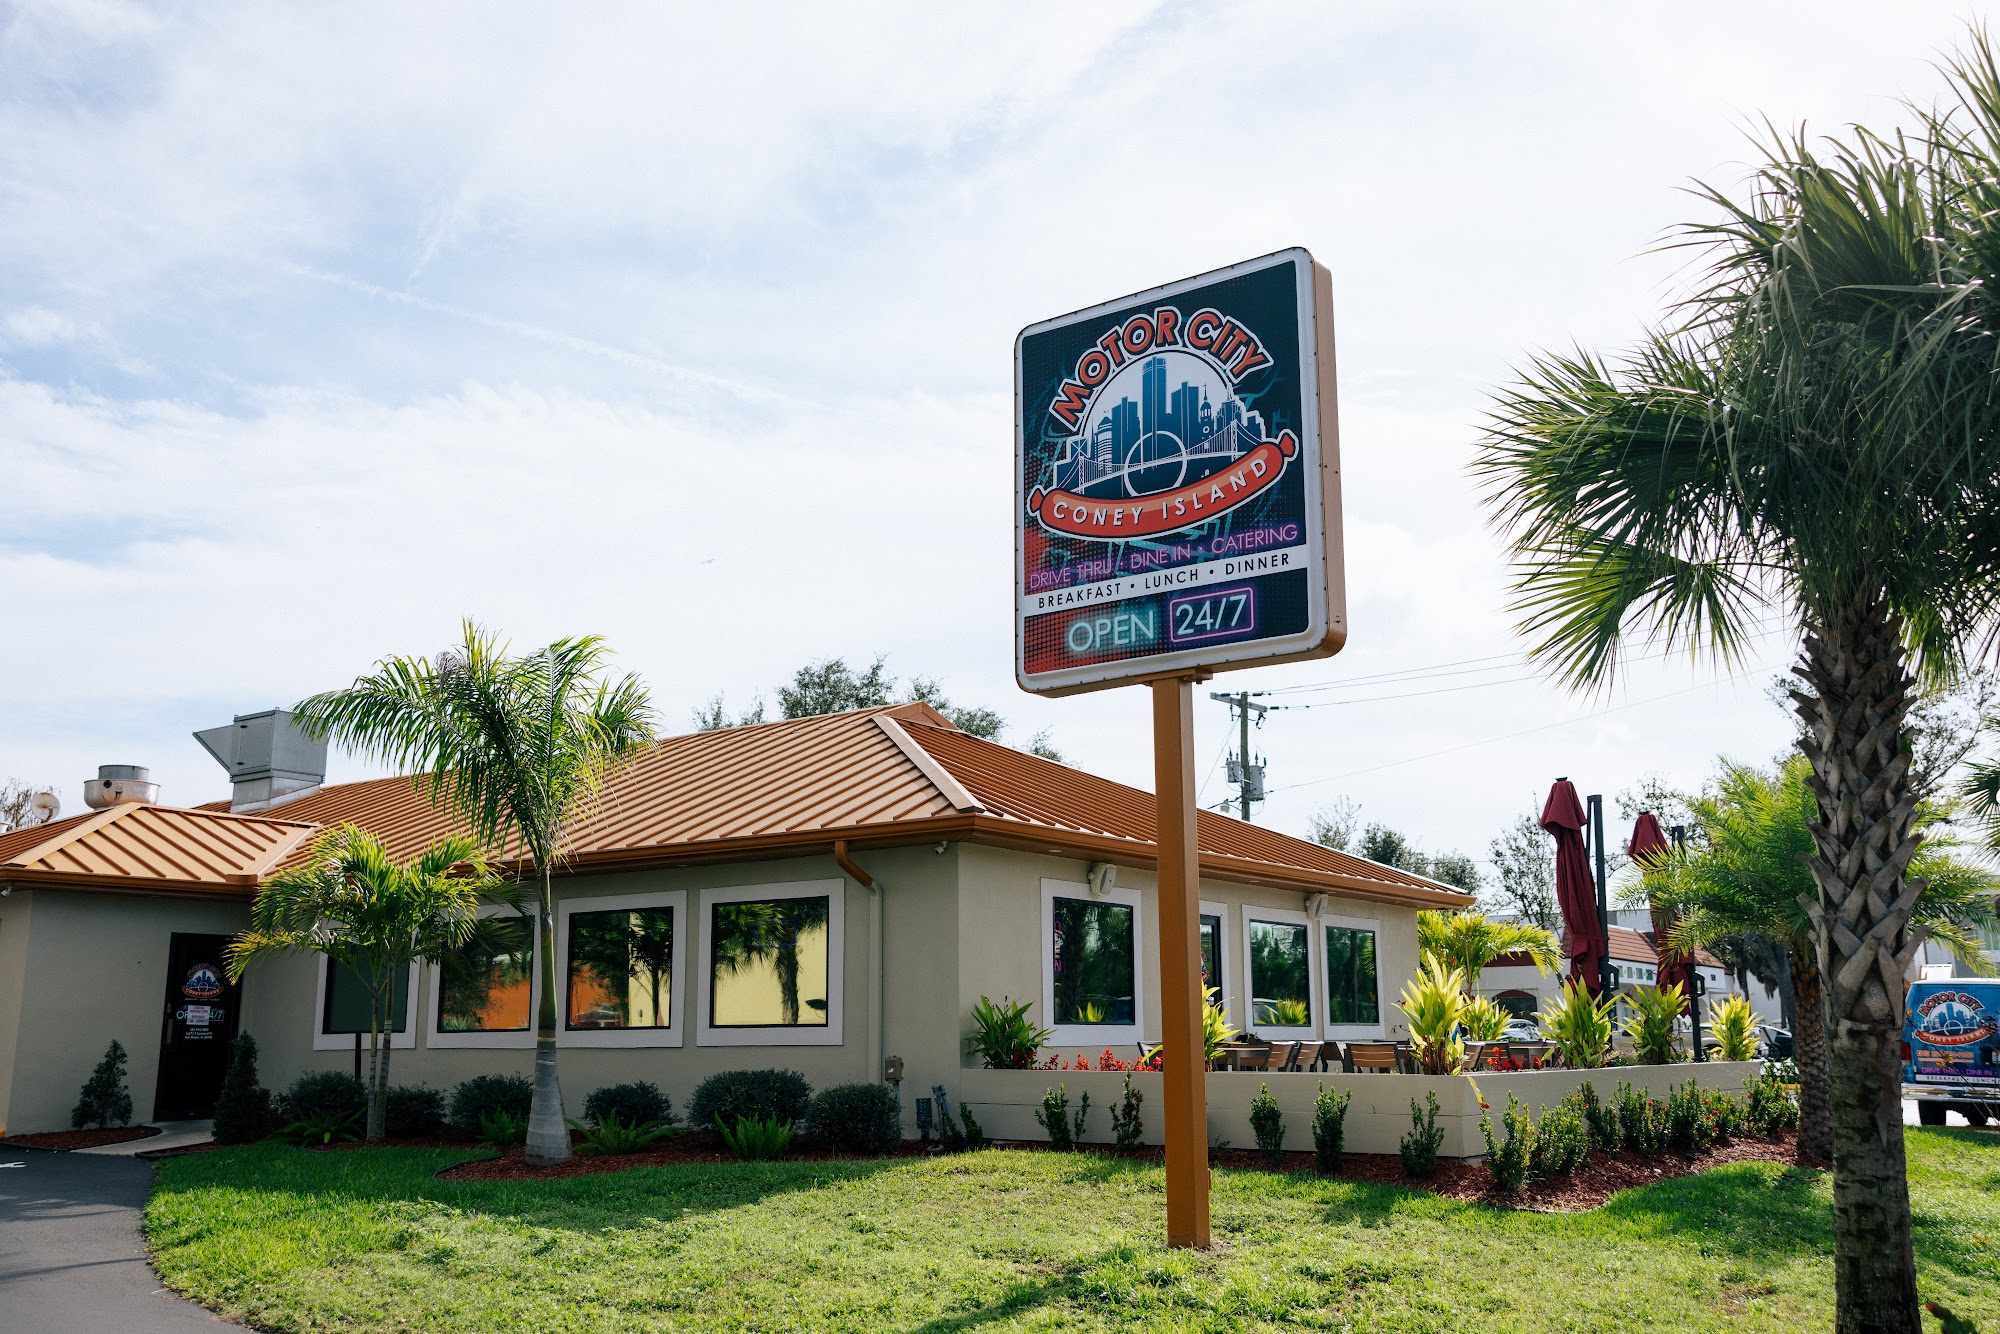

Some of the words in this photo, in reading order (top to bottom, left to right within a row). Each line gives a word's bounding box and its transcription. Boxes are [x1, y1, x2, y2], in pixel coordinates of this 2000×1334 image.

[1051, 307, 1182, 427] MOTOR
[1186, 309, 1273, 383] CITY
[1053, 500, 1144, 527] CONEY
[1162, 459, 1268, 519] ISLAND
[1030, 566, 1071, 589] DRIVE
[1076, 557, 1113, 582] THRU
[1130, 548, 1168, 570] DINE
[1172, 543, 1192, 563] IN
[1211, 524, 1298, 556] CATERING
[1038, 582, 1121, 609] BREAKFAST
[1144, 567, 1199, 591] LUNCH
[1224, 552, 1290, 577] DINNER
[1068, 609, 1155, 652] OPEN
[1175, 594, 1248, 636] 24/7
[1919, 992, 1955, 1017] MOTOR
[1957, 992, 1984, 1011] CITY
[1956, 1029, 1986, 1042] ISLAND
